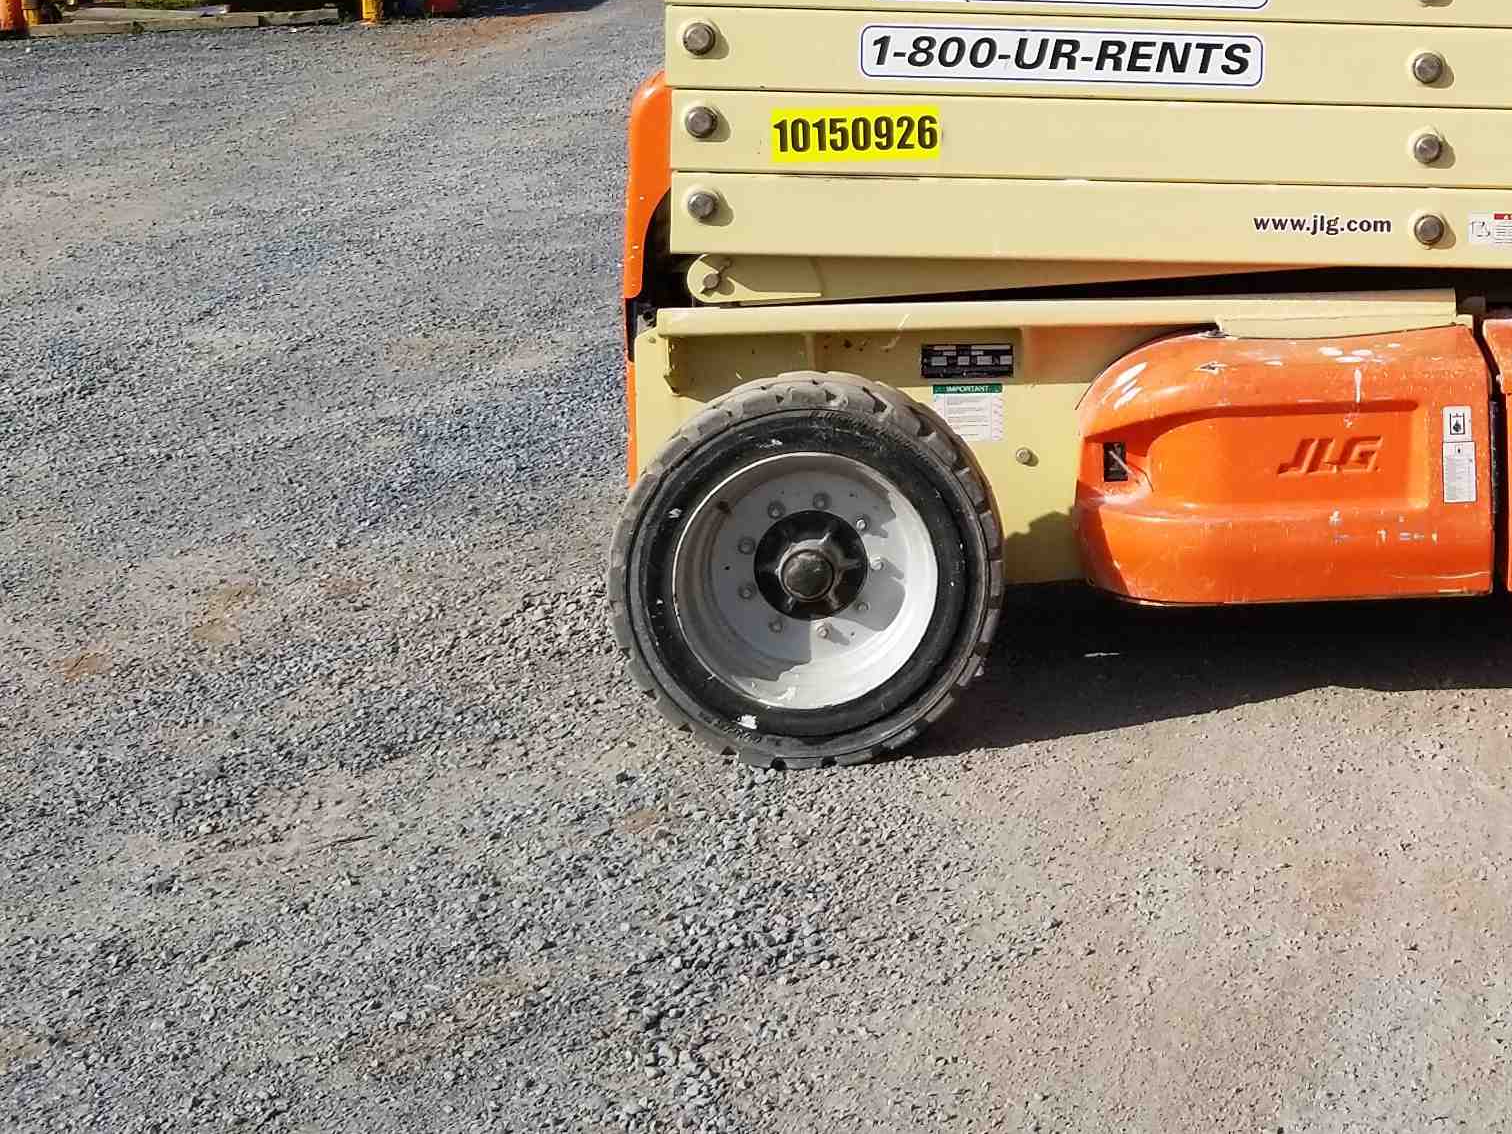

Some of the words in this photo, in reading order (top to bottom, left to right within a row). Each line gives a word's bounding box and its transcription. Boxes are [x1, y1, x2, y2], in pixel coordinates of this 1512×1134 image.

[871, 35, 1252, 75] 1-800-UR-RENTS
[773, 115, 939, 152] 10150926
[1253, 214, 1393, 236] www.jlg.com
[945, 385, 989, 393] IMPORTANT
[1276, 435, 1384, 474] JLG
